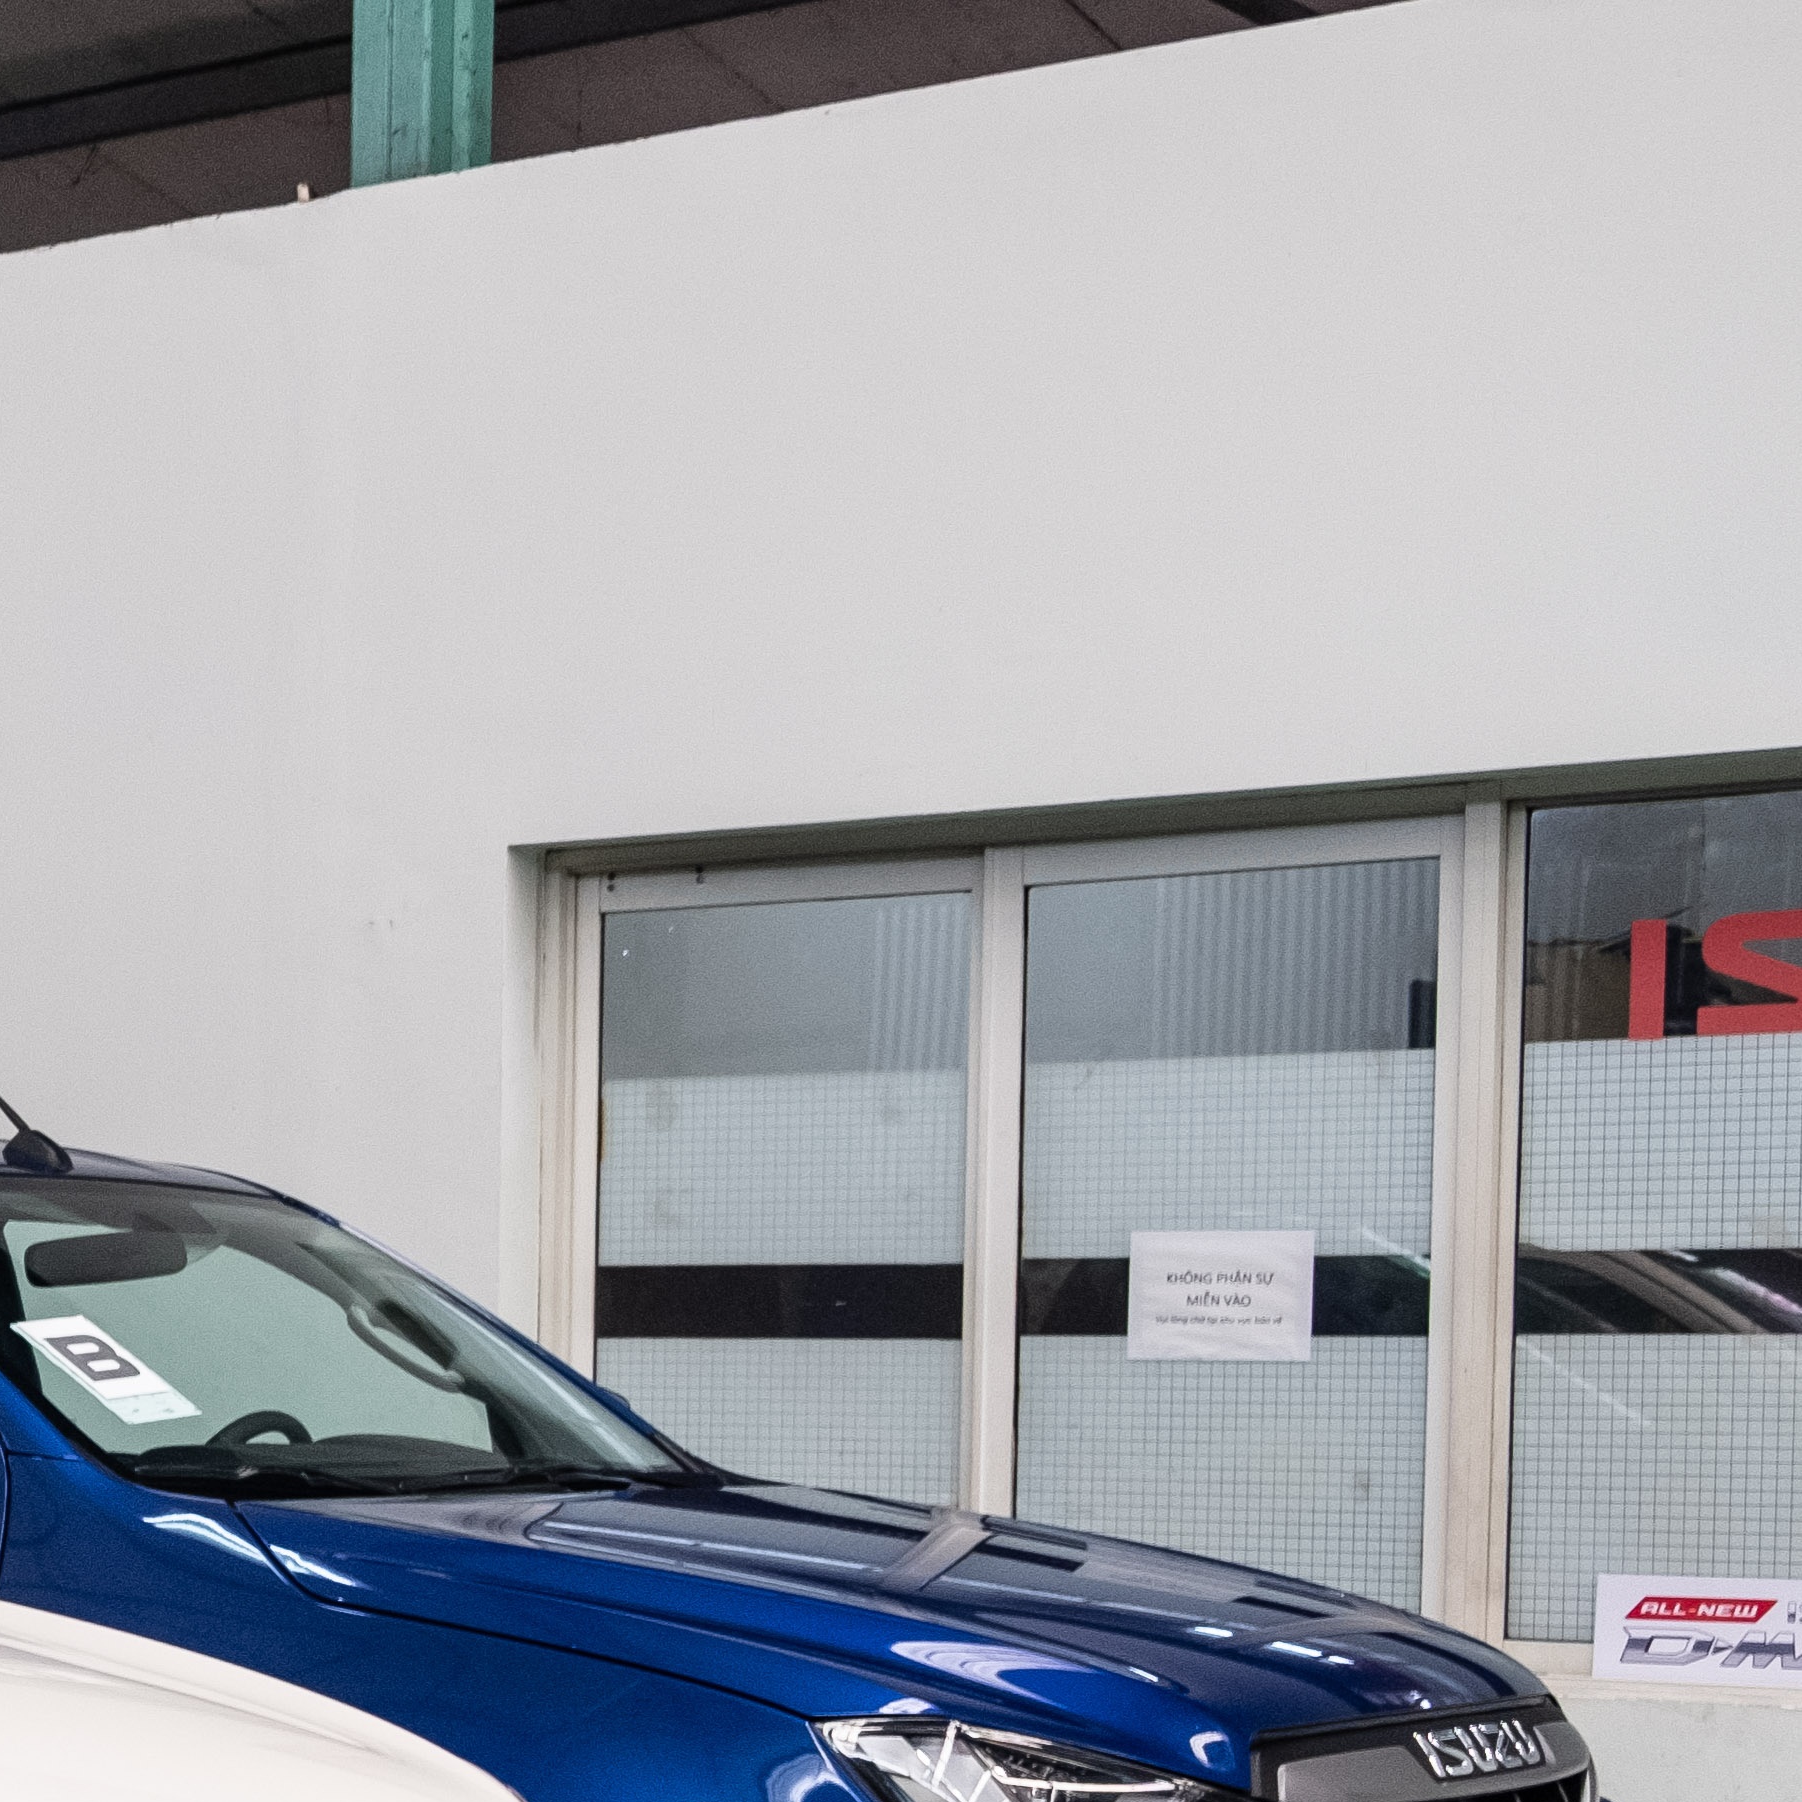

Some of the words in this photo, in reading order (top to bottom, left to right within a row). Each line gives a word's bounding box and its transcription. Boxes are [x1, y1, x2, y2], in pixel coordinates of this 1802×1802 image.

[1167, 1270, 1212, 1285] KHÔNG
[1223, 1293, 1251, 1307] VÀO
[44, 1335, 140, 1381] B
[1640, 1601, 1758, 1618] ALL-NEW
[1413, 1718, 1540, 1778] ISUZU
